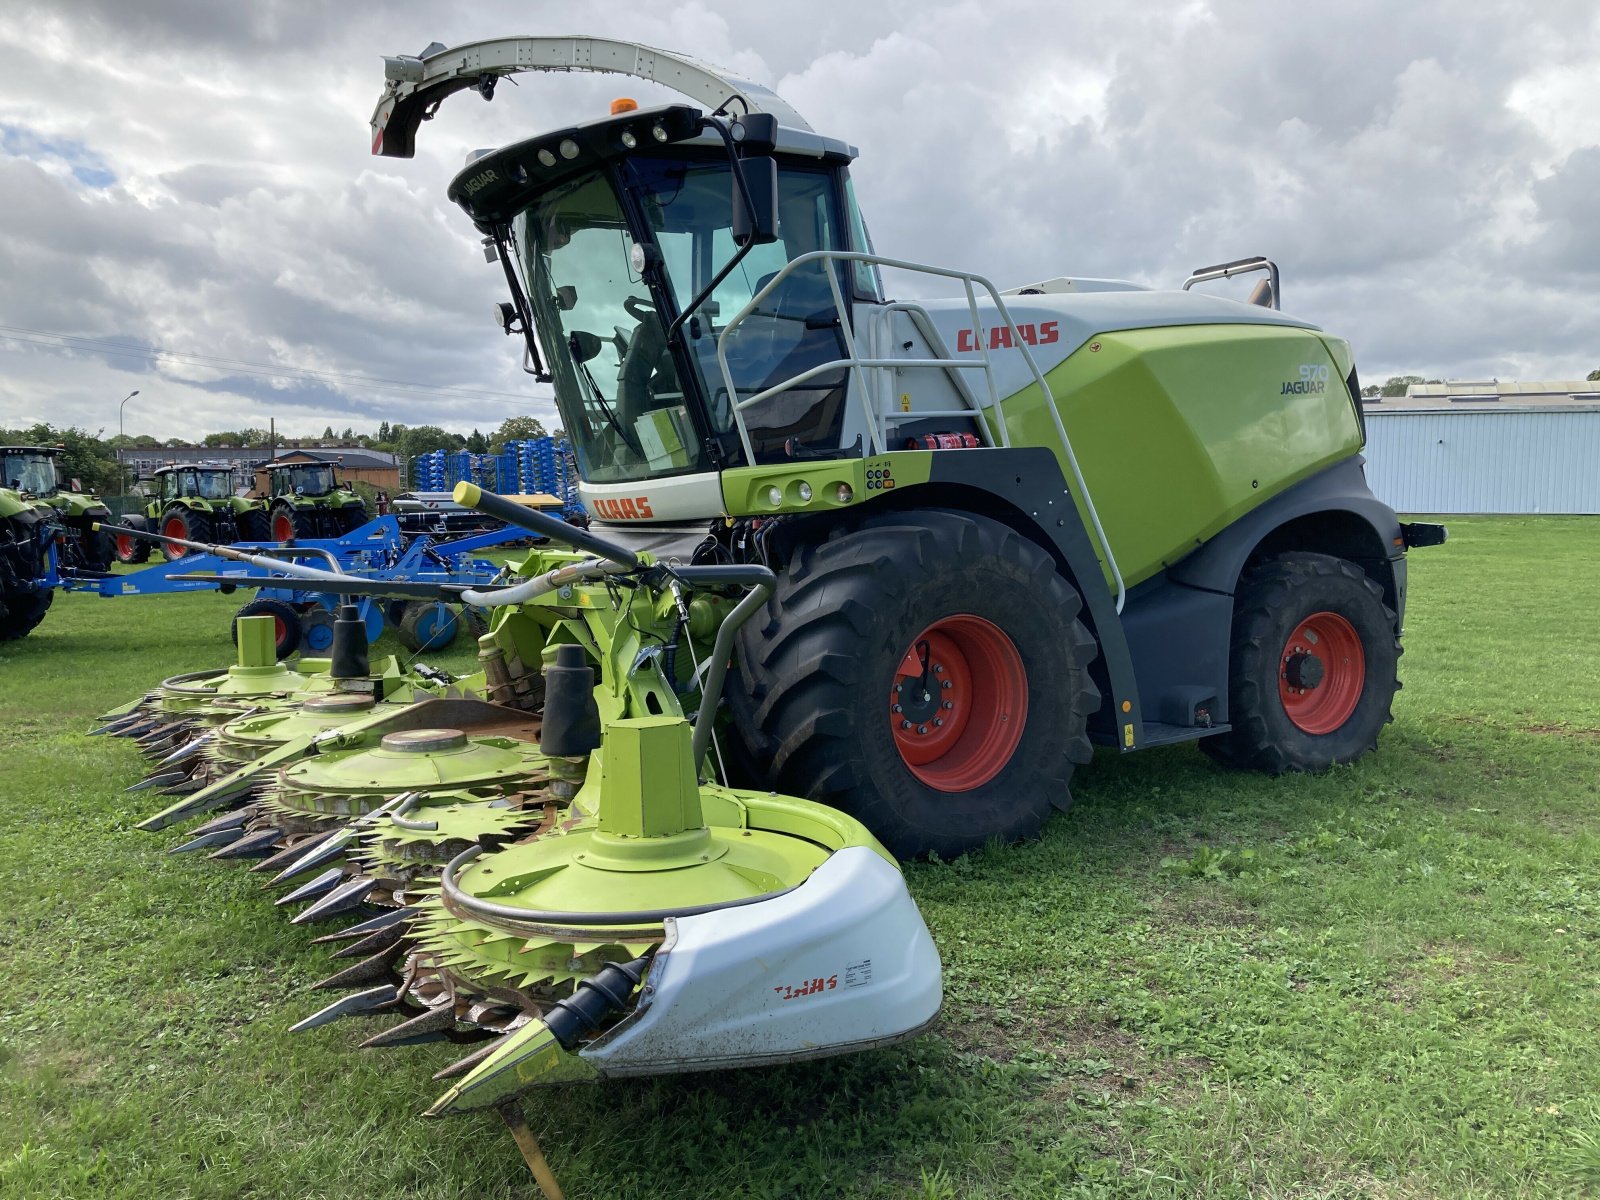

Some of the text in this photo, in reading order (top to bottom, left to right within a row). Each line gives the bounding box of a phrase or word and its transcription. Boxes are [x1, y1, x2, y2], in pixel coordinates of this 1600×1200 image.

[464, 170, 499, 196] JAGUAR
[1299, 364, 1329, 381] 970
[1280, 381, 1325, 395] JAGUAR
[593, 496, 653, 519] CLAAS
